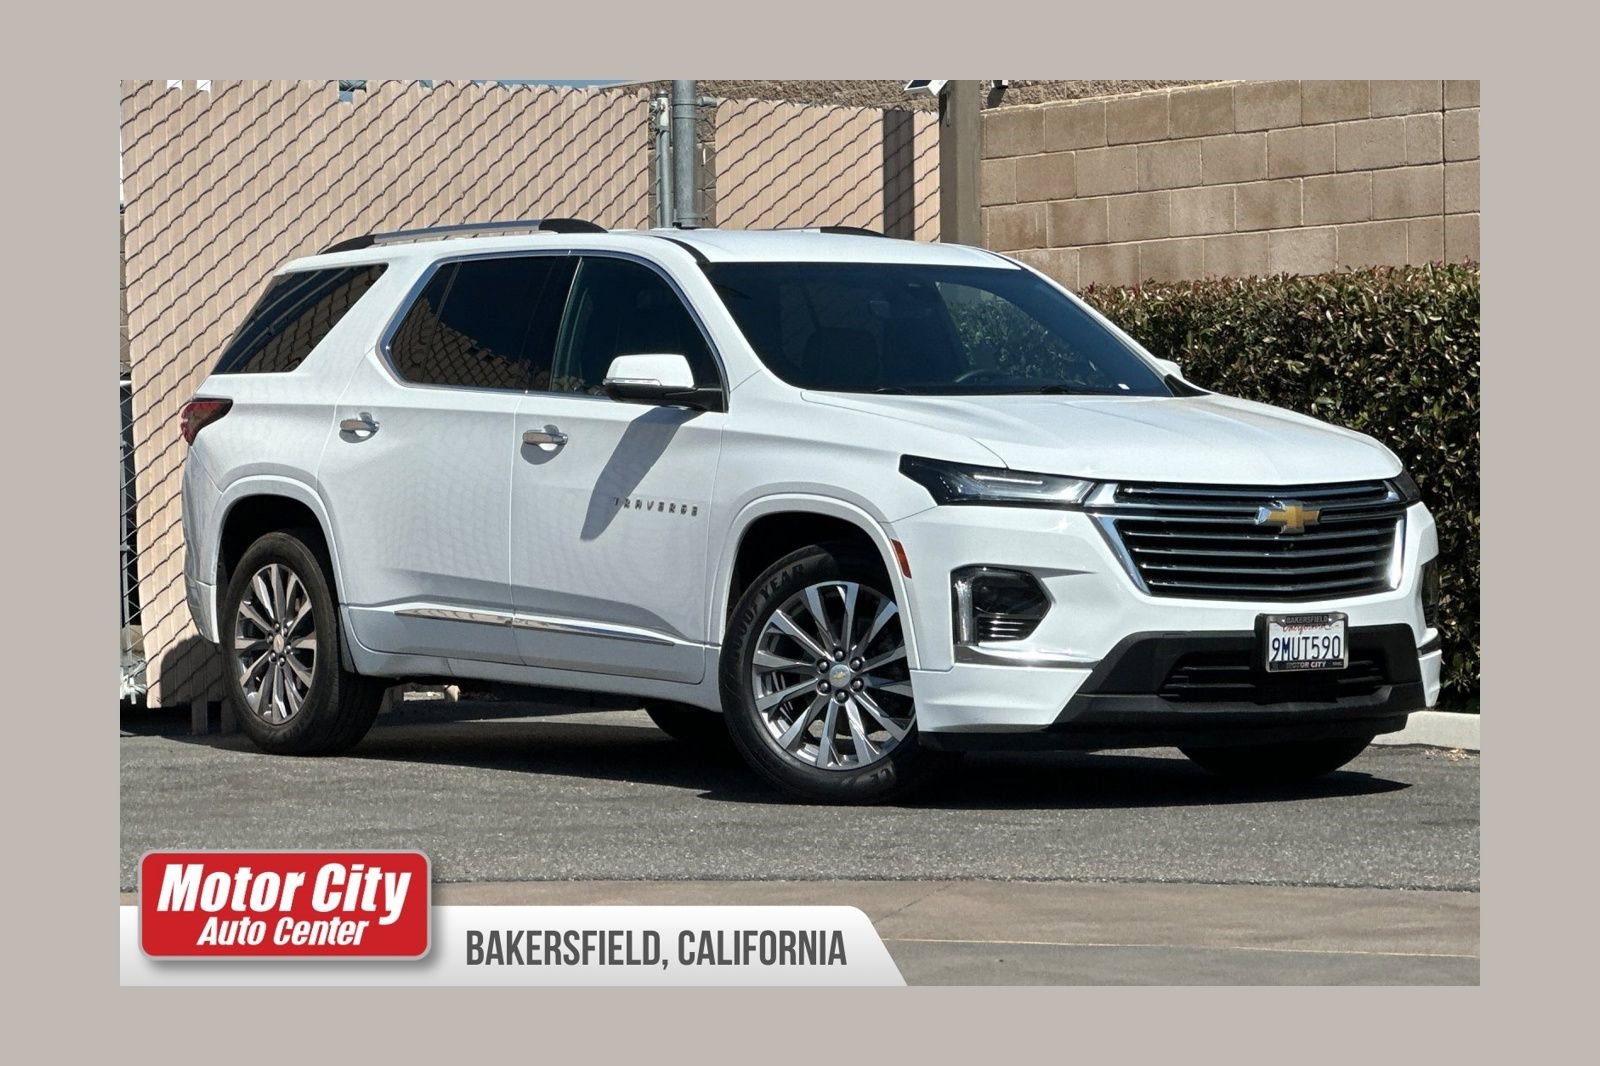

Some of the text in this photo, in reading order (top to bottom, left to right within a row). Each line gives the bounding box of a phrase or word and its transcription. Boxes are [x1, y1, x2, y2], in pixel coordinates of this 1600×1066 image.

[609, 497, 698, 517] TRAVERSE
[1286, 616, 1328, 624] BAKERSFIELD
[1271, 635, 1341, 662] 9MUT590
[1286, 661, 1310, 669] MOTOR
